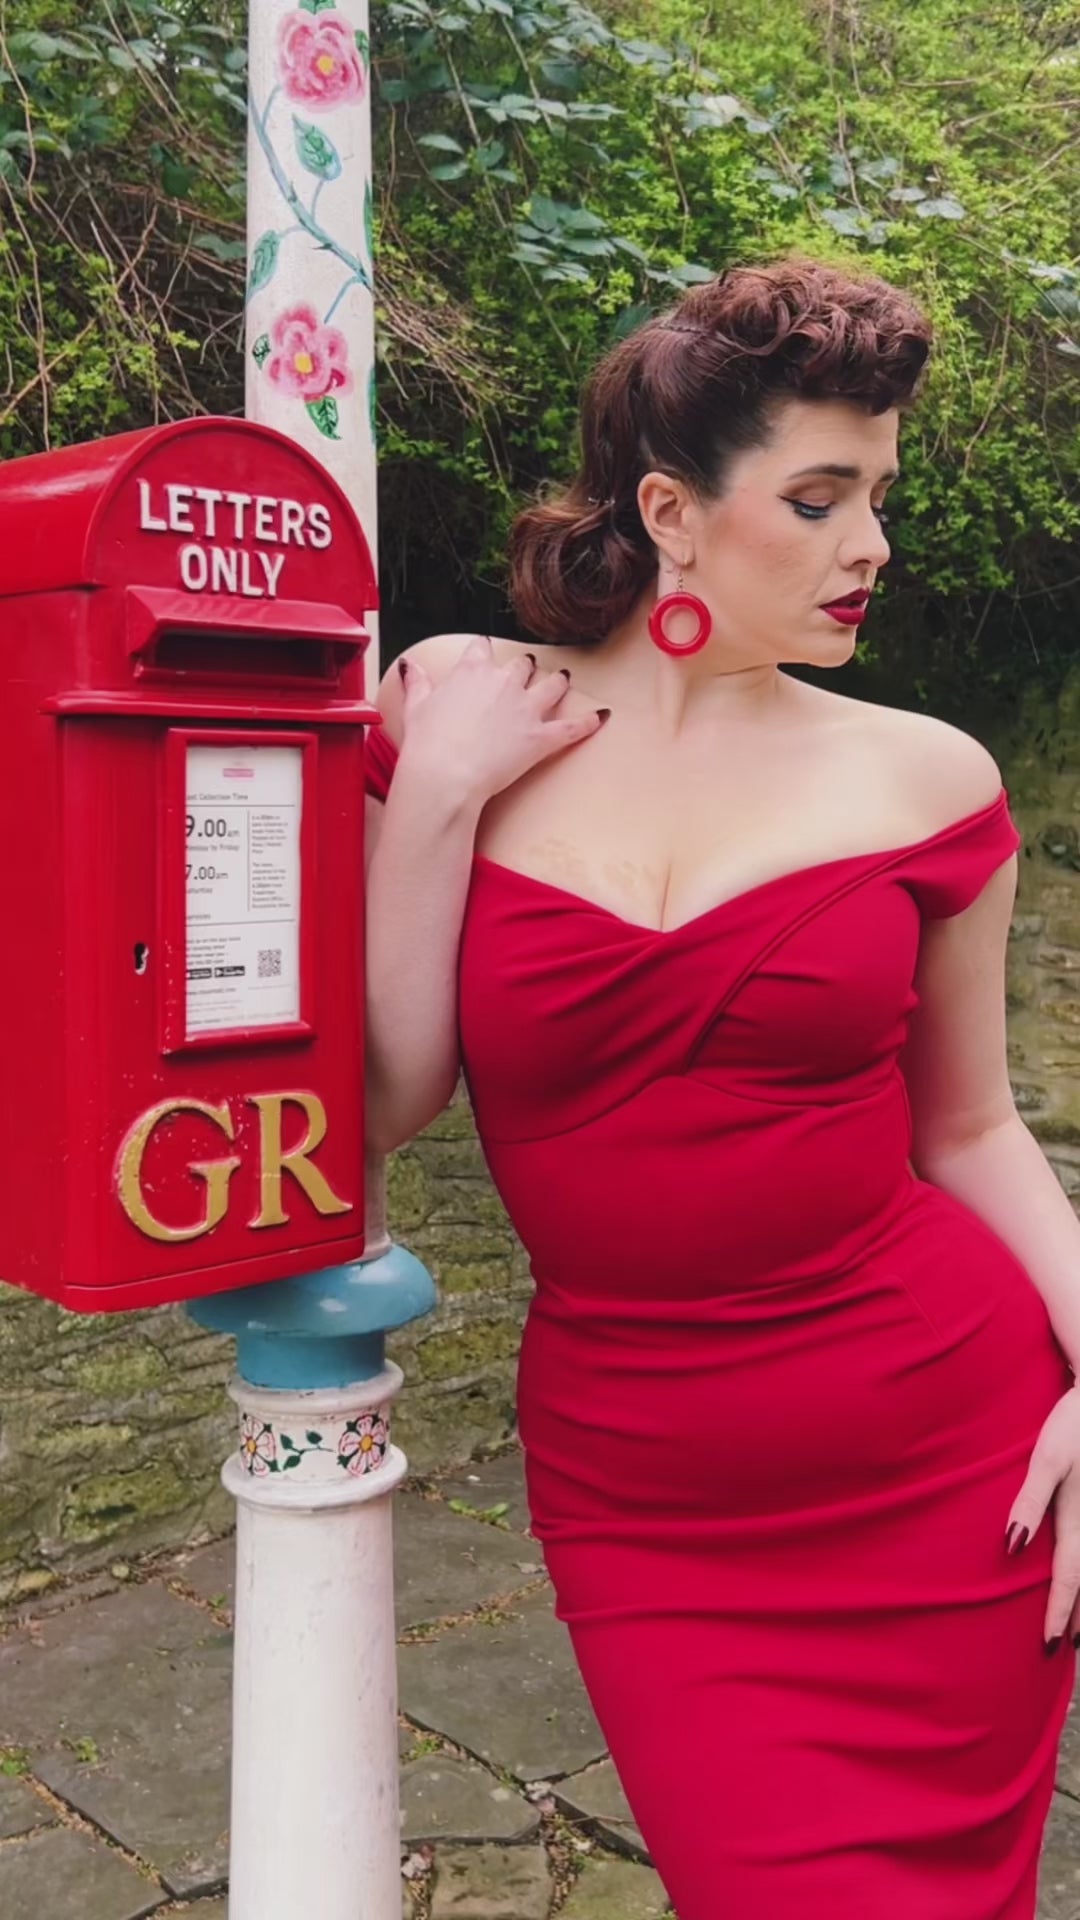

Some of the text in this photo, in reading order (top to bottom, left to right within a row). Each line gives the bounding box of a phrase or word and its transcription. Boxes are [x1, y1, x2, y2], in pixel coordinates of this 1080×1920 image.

[138, 478, 333, 549] LETTERS
[179, 543, 285, 598] ONLY
[232, 792, 248, 801] Time
[219, 844, 240, 852] Friday
[187, 887, 213, 895] aturday
[115, 1091, 353, 1242] GR
